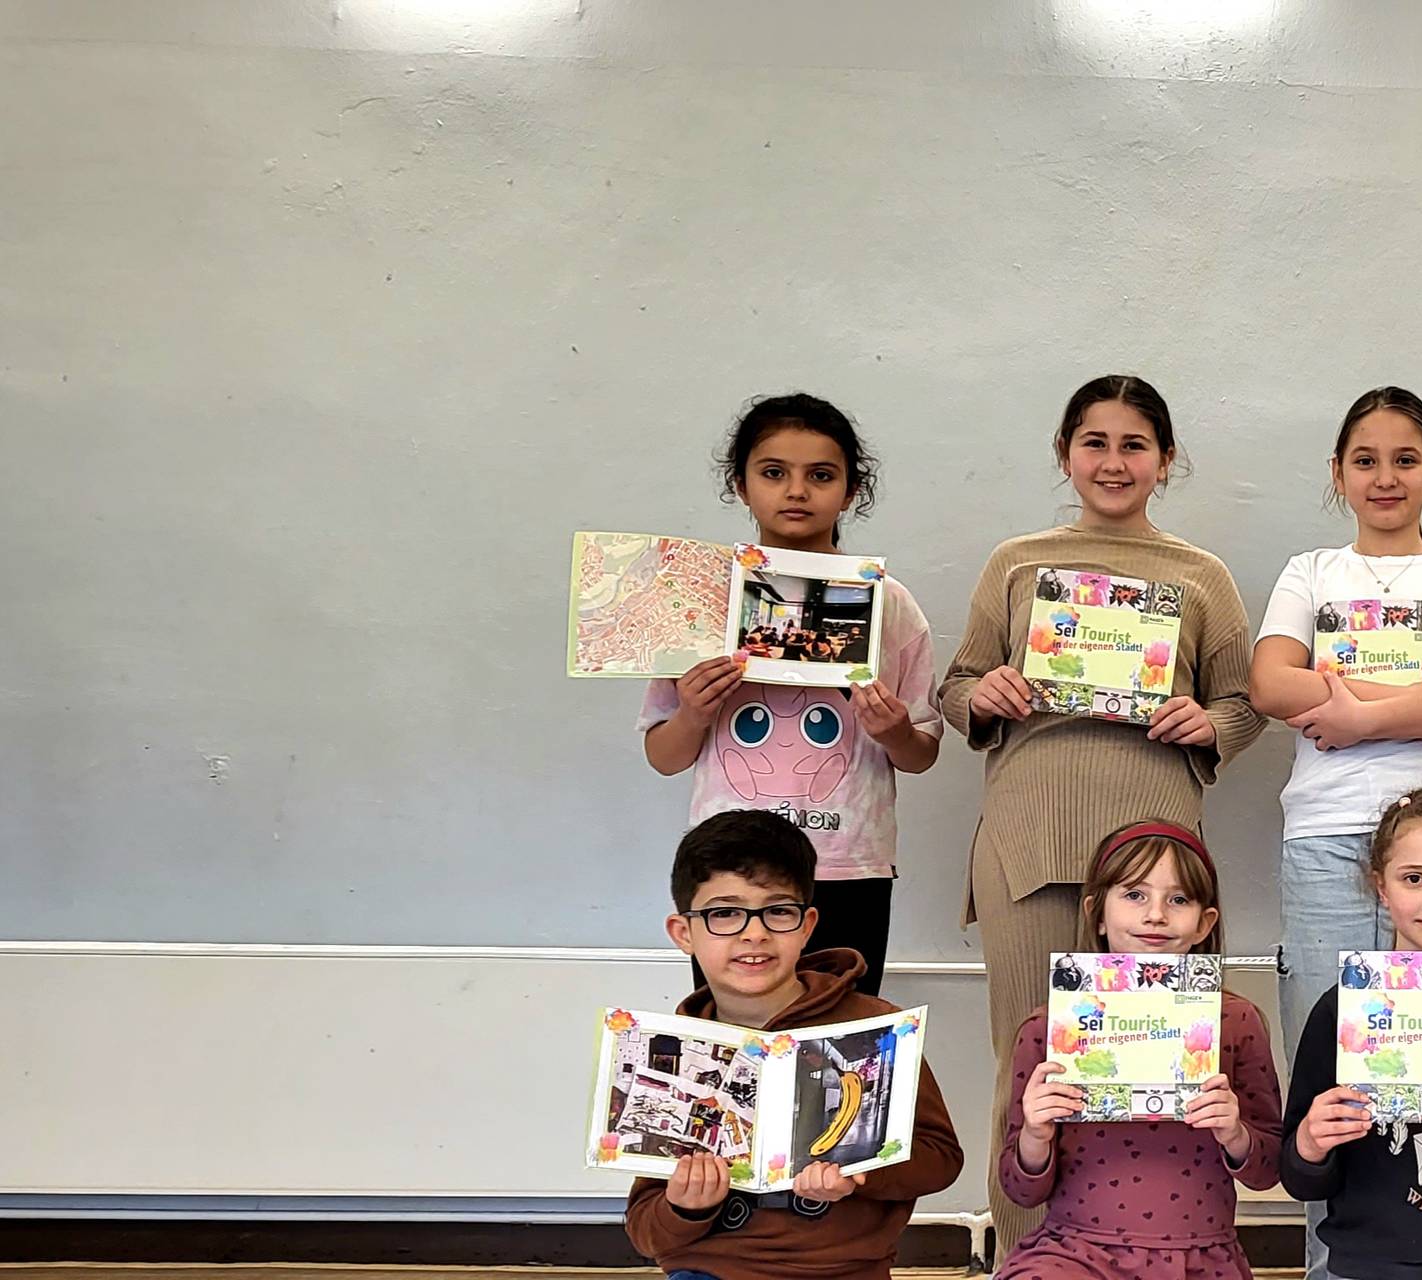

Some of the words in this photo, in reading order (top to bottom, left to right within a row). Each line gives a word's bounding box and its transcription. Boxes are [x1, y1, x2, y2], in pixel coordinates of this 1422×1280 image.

[1054, 622, 1076, 638] Sei
[1081, 625, 1132, 645] Tourist
[1052, 639, 1061, 649] in
[1063, 640, 1078, 650] der
[1079, 641, 1114, 652] eigenen
[1337, 650, 1356, 665] Sei
[1359, 649, 1409, 664] Tourist
[1337, 668, 1345, 677] in
[1345, 666, 1359, 676] der
[1360, 664, 1393, 675] eigenen
[1078, 1015, 1104, 1031] Sei
[1107, 1015, 1168, 1031] Tourist
[1367, 1013, 1392, 1030] Sei
[1078, 1036, 1087, 1047] in
[1089, 1035, 1106, 1046] der
[1108, 1032, 1148, 1045] eigenen
[1150, 1028, 1181, 1040] Stadt!
[1367, 1034, 1377, 1045] in
[1379, 1034, 1396, 1045] der
